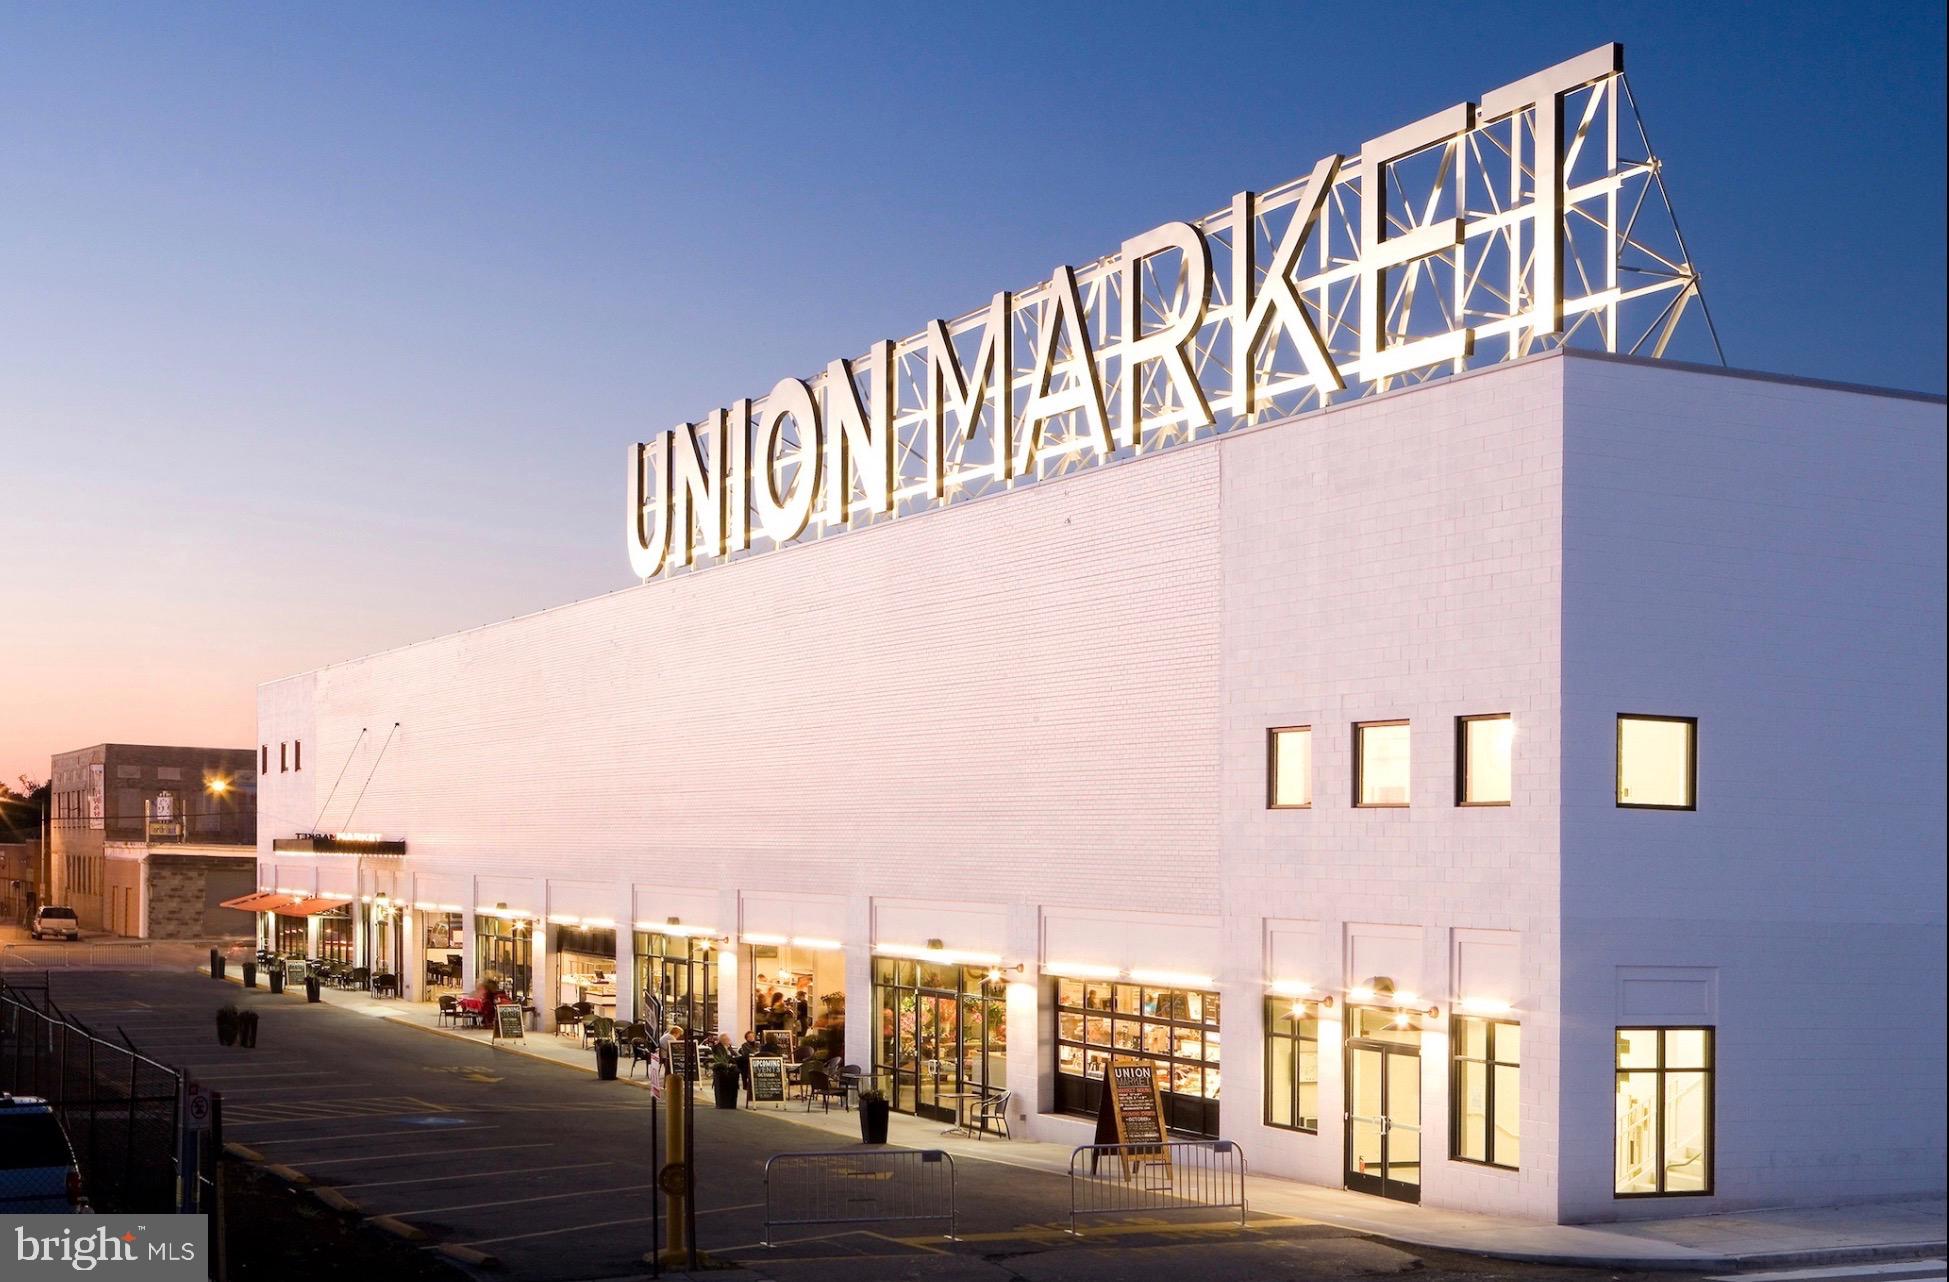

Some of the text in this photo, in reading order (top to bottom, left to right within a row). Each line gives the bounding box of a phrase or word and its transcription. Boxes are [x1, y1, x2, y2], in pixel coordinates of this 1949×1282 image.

[627, 41, 1624, 579] UNION MARKET
[1114, 1067, 1151, 1078] UNION
